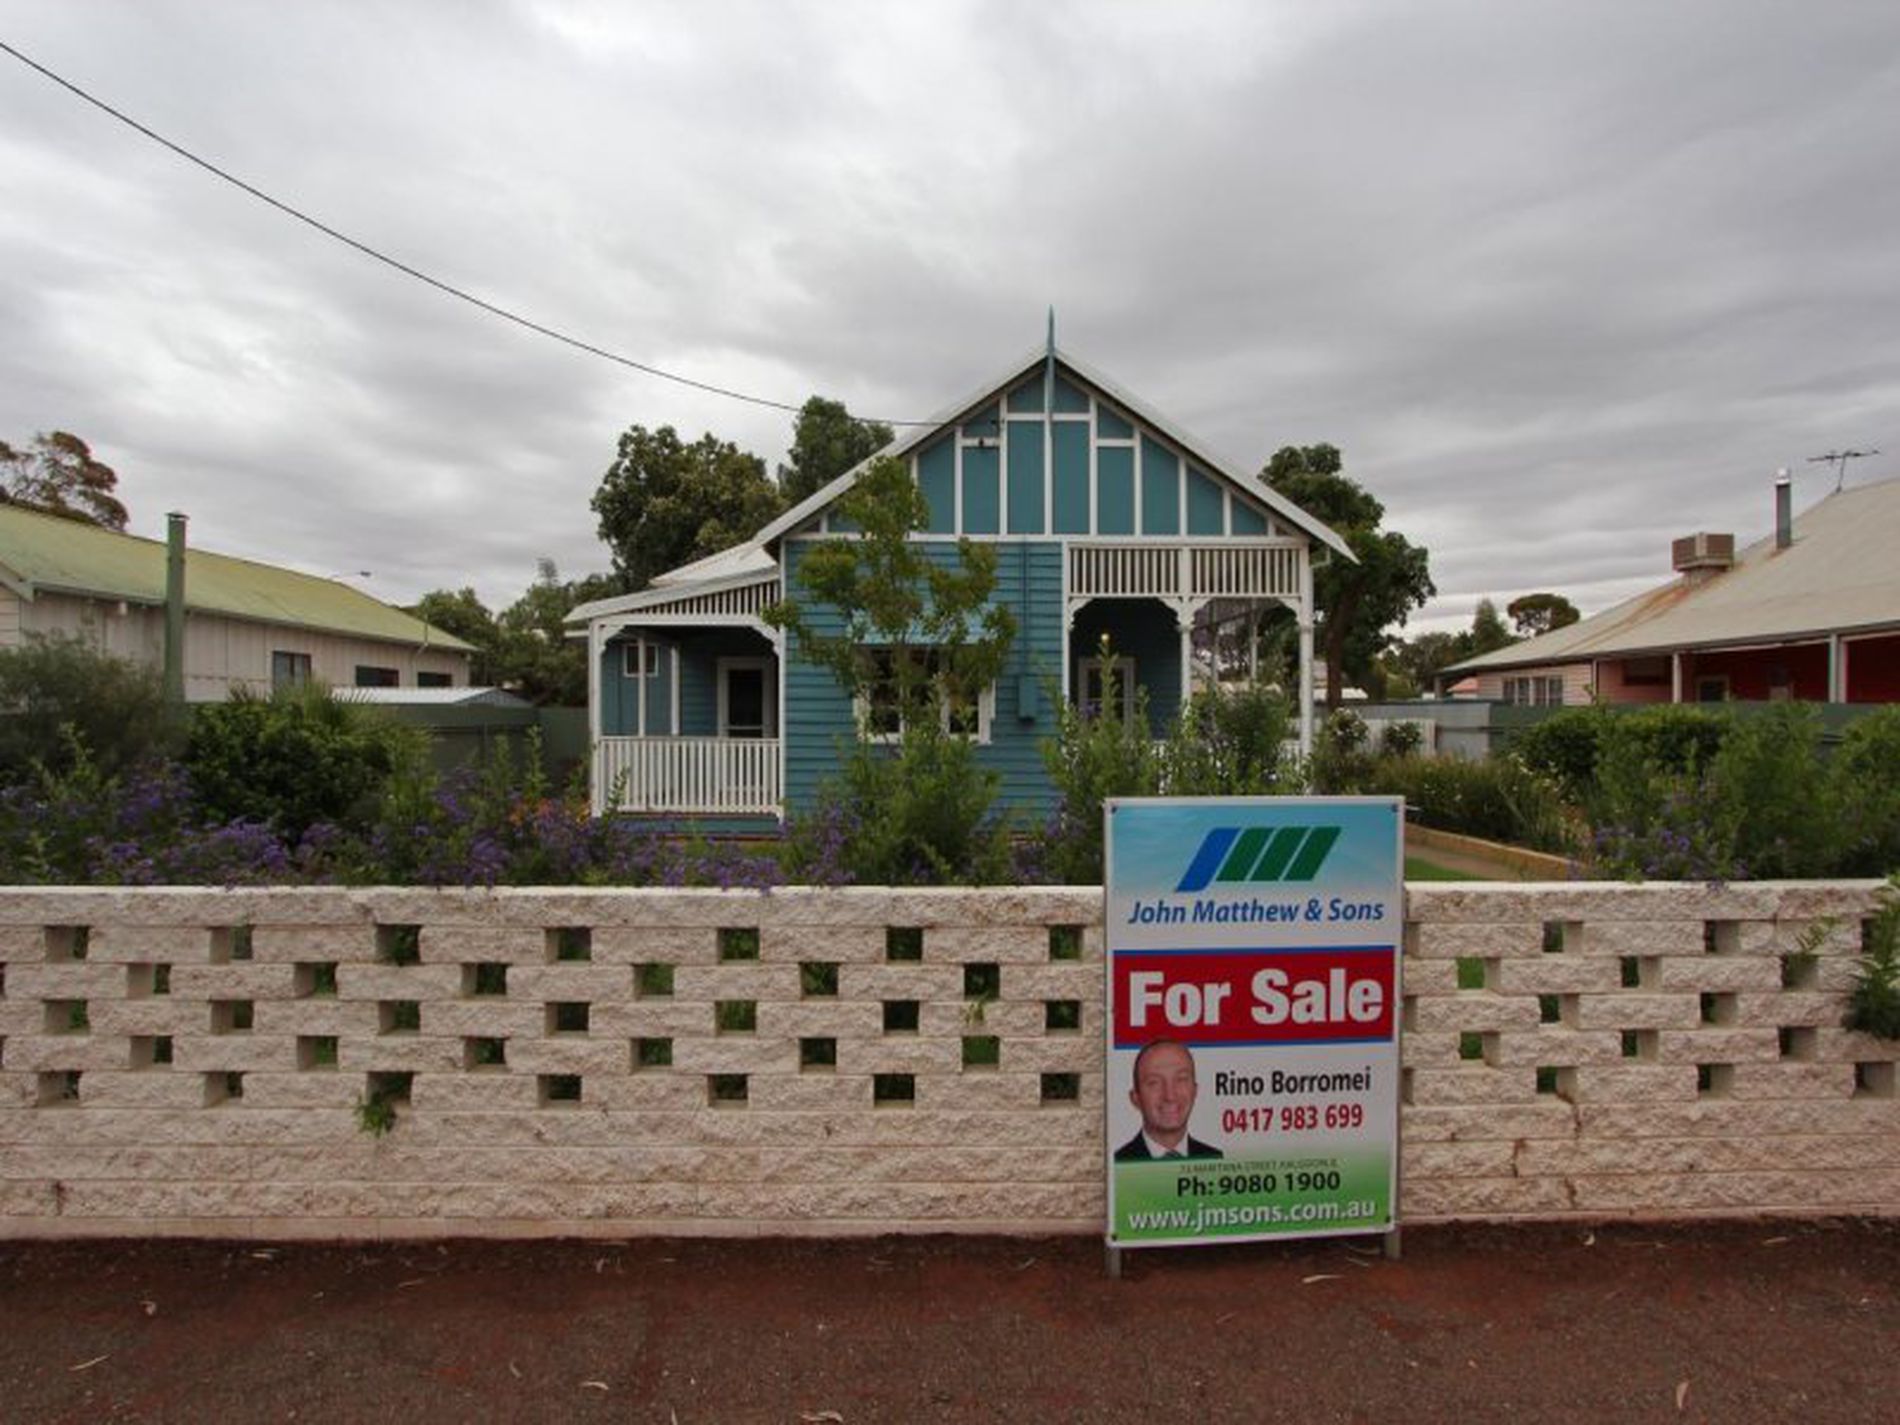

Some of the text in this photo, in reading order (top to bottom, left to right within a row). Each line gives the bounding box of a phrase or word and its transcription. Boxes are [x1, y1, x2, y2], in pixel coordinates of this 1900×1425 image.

[1128, 898, 1385, 925] John Matthew & Sons
[1129, 968, 1384, 1027] For Sale
[1215, 1066, 1372, 1096] Rino Borromei
[1222, 1104, 1363, 1133] 0417 983 699
[1177, 1171, 1341, 1197] Ph: 9080 1900
[1128, 1198, 1376, 1235] www.jmsons.com.au
